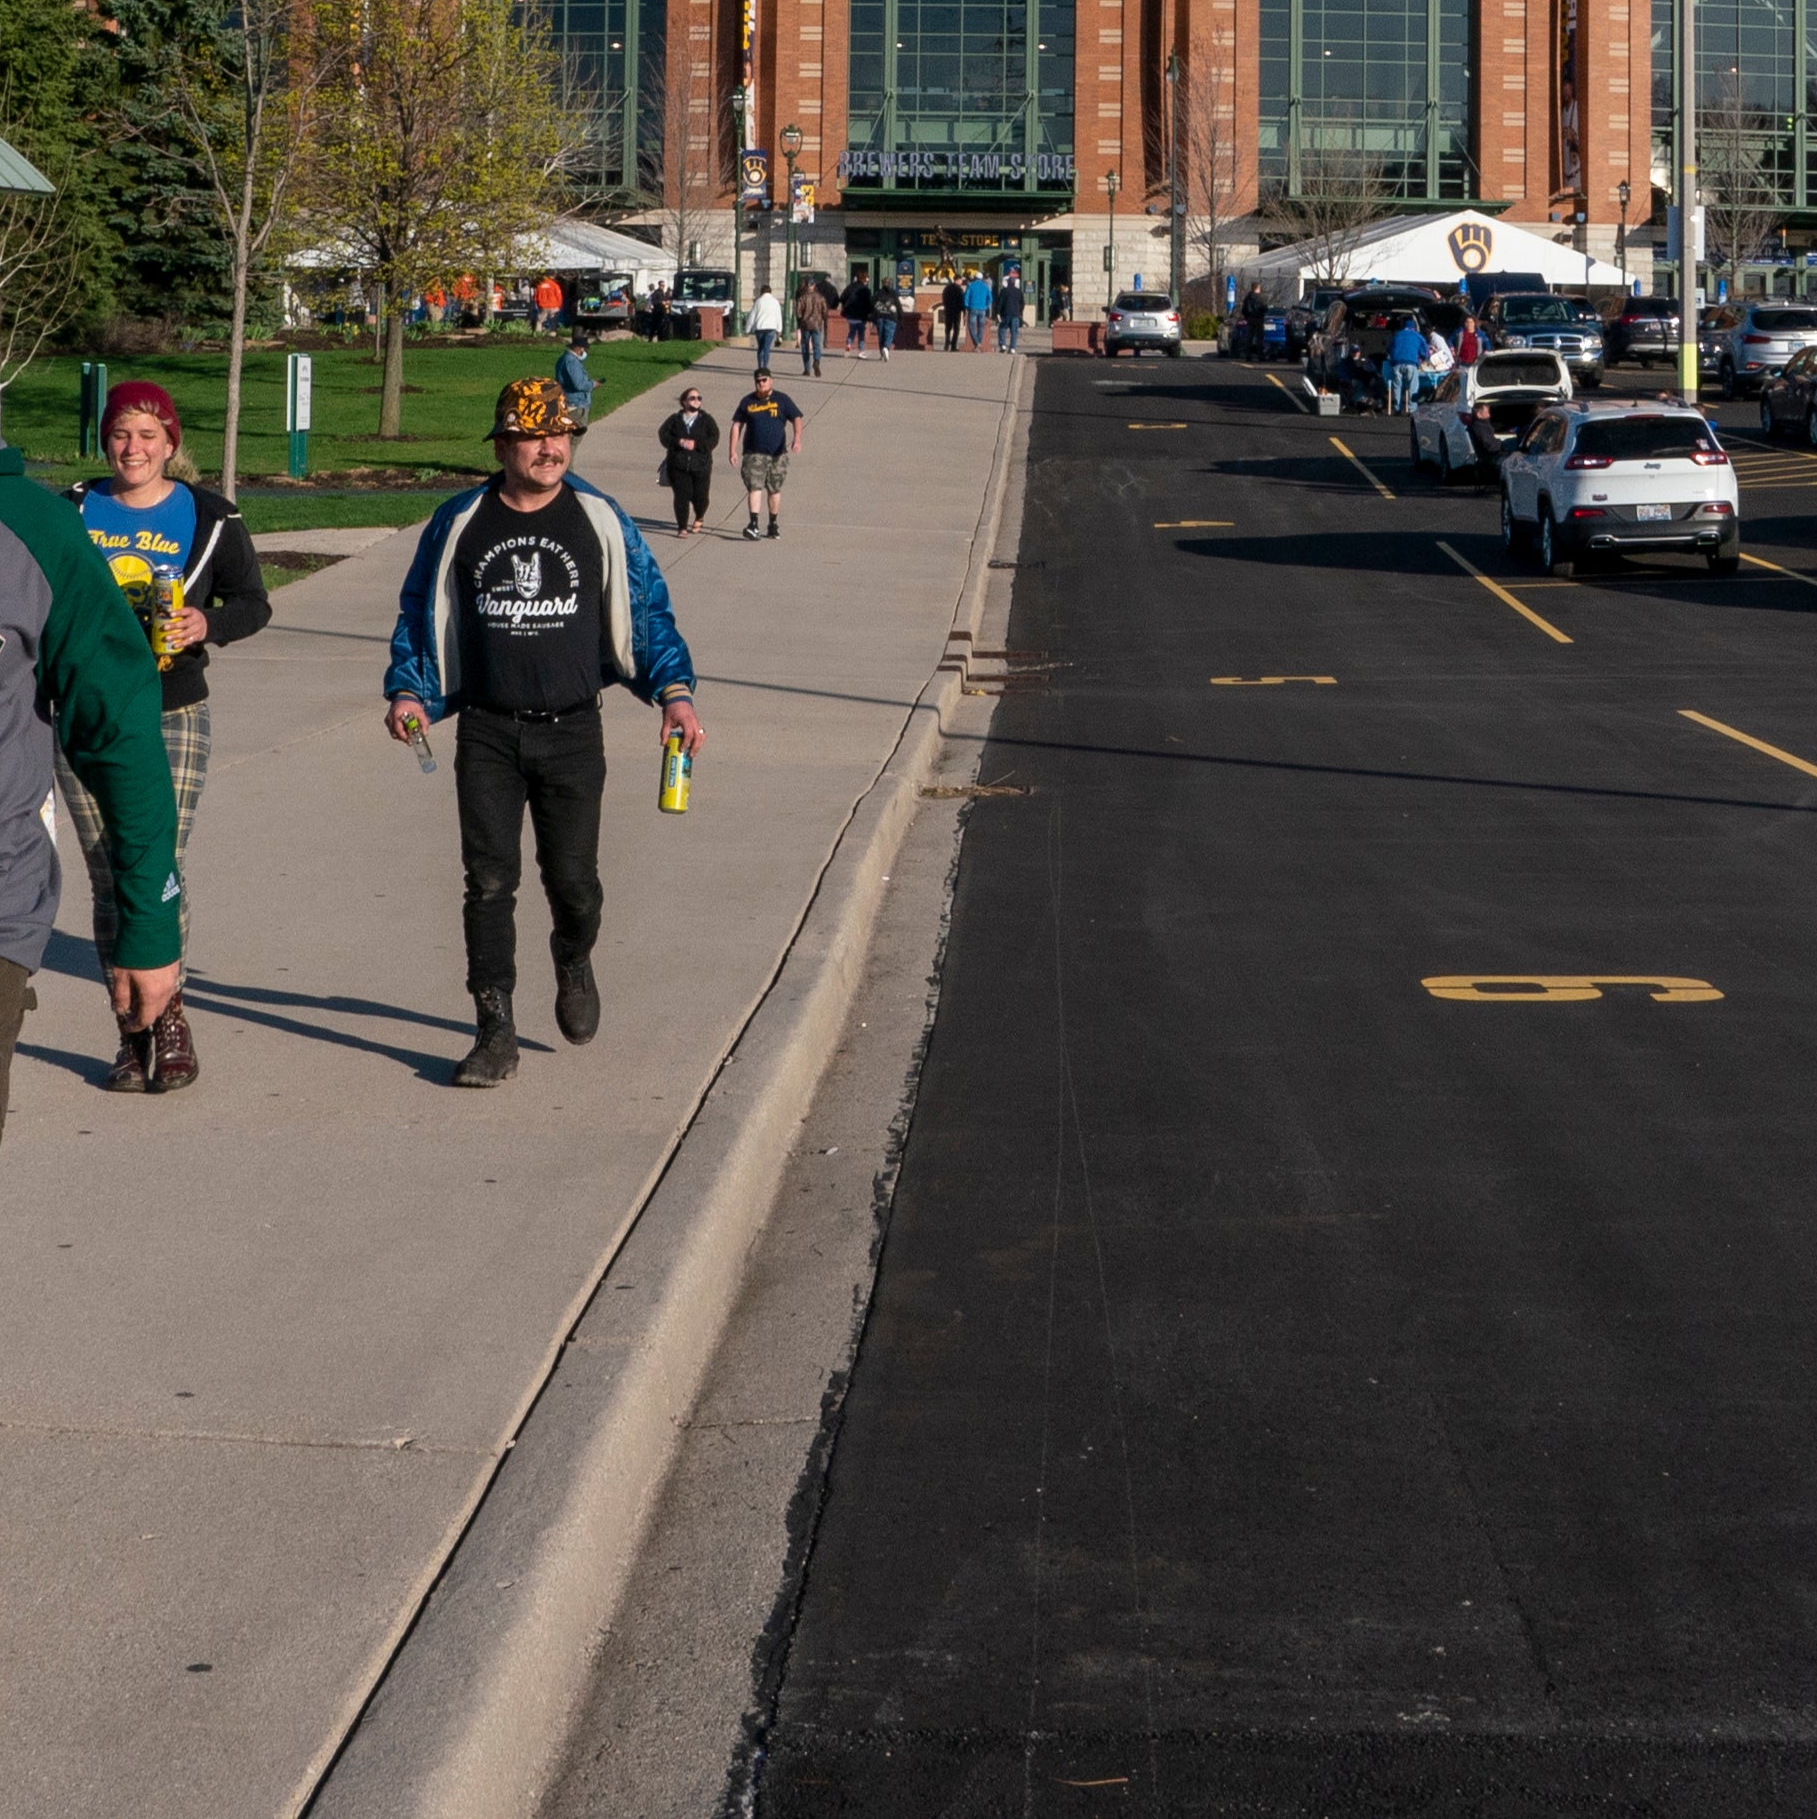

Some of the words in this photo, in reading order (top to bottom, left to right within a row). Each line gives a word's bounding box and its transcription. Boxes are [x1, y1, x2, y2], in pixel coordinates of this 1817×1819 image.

[839, 150, 934, 178] BREWERS
[946, 152, 1000, 180] TEAM
[1010, 153, 1074, 181] STORE
[960, 234, 999, 247] STORE
[1643, 462, 1661, 470] Jeep
[88, 529, 131, 549] True
[135, 531, 181, 554] Blue
[473, 536, 536, 589] CHAMPIONS
[539, 537, 563, 554] EAT
[560, 551, 580, 588] HERE
[475, 592, 579, 623] Vanguard
[1210, 676, 1338, 685] 5
[1420, 975, 1725, 1002] 6
